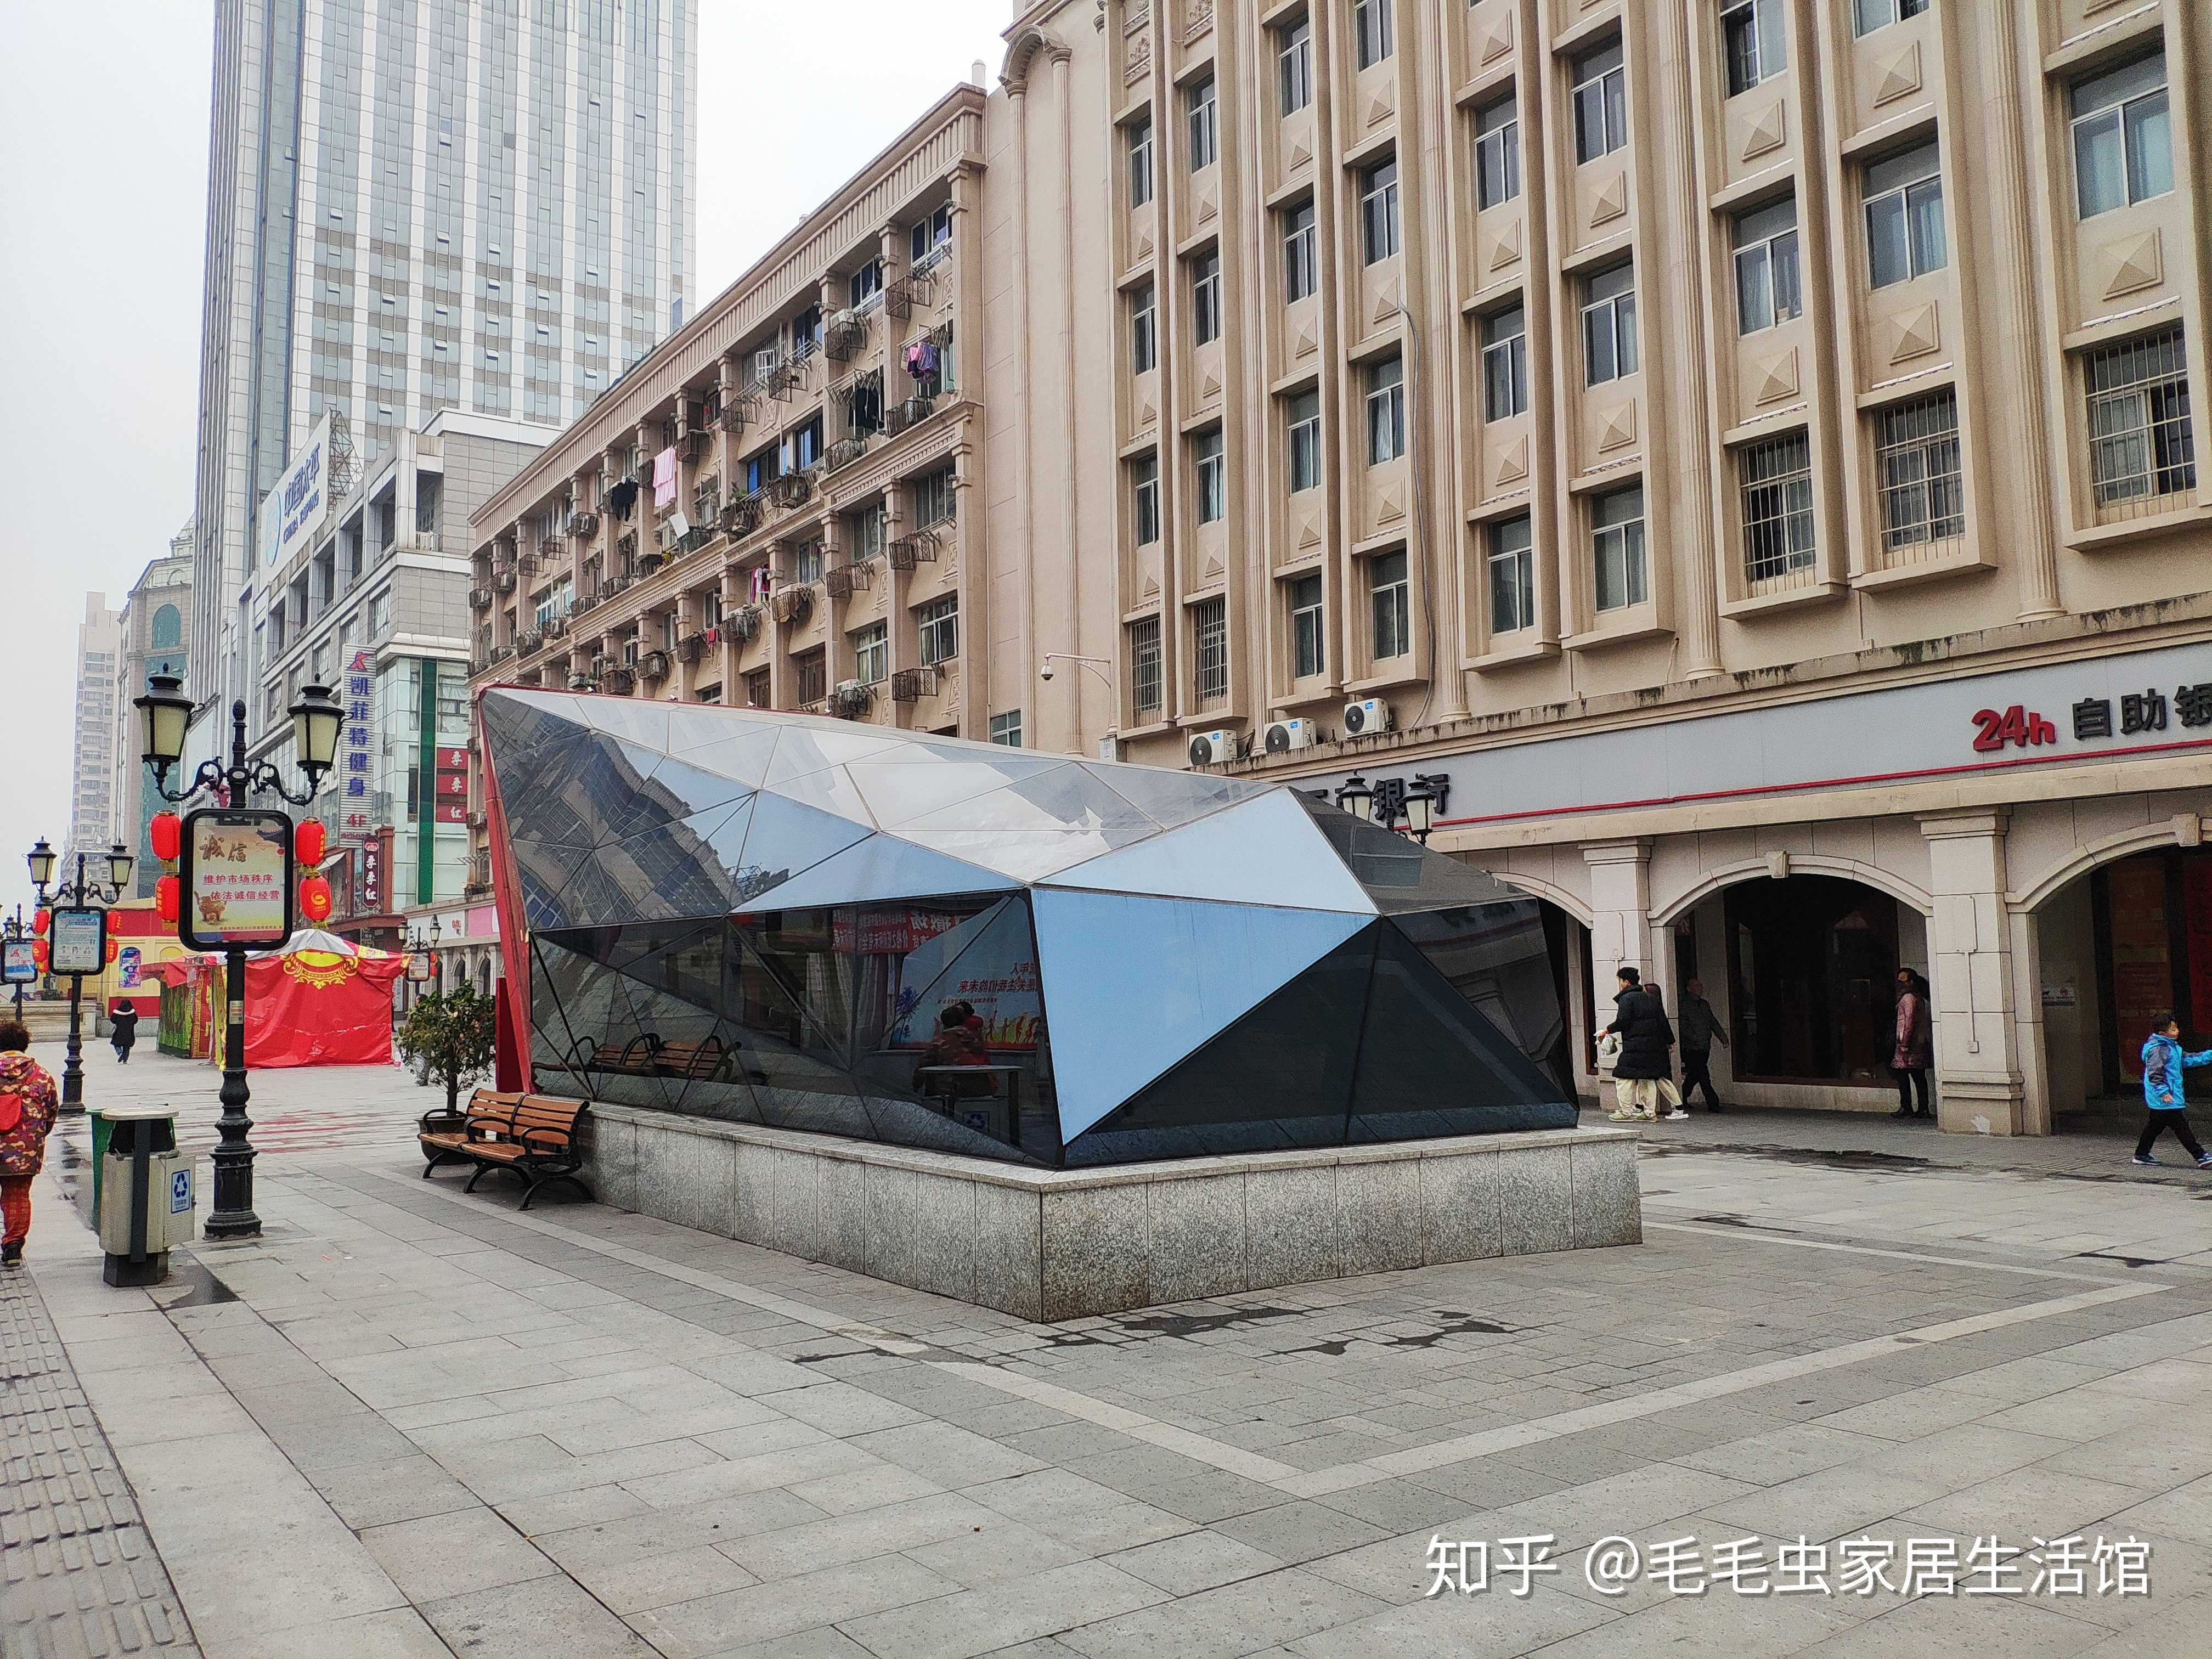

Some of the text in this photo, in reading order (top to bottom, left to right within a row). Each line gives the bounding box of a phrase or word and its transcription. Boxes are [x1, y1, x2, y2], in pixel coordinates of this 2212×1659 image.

[284, 442, 320, 518] 中国太平
[1971, 704, 2057, 751] 24h
[347, 813, 367, 827] 4F
[203, 873, 273, 885] 维护市场秩序
[365, 855, 377, 900] 季季红
[210, 890, 281, 900] 依法诚信经营
